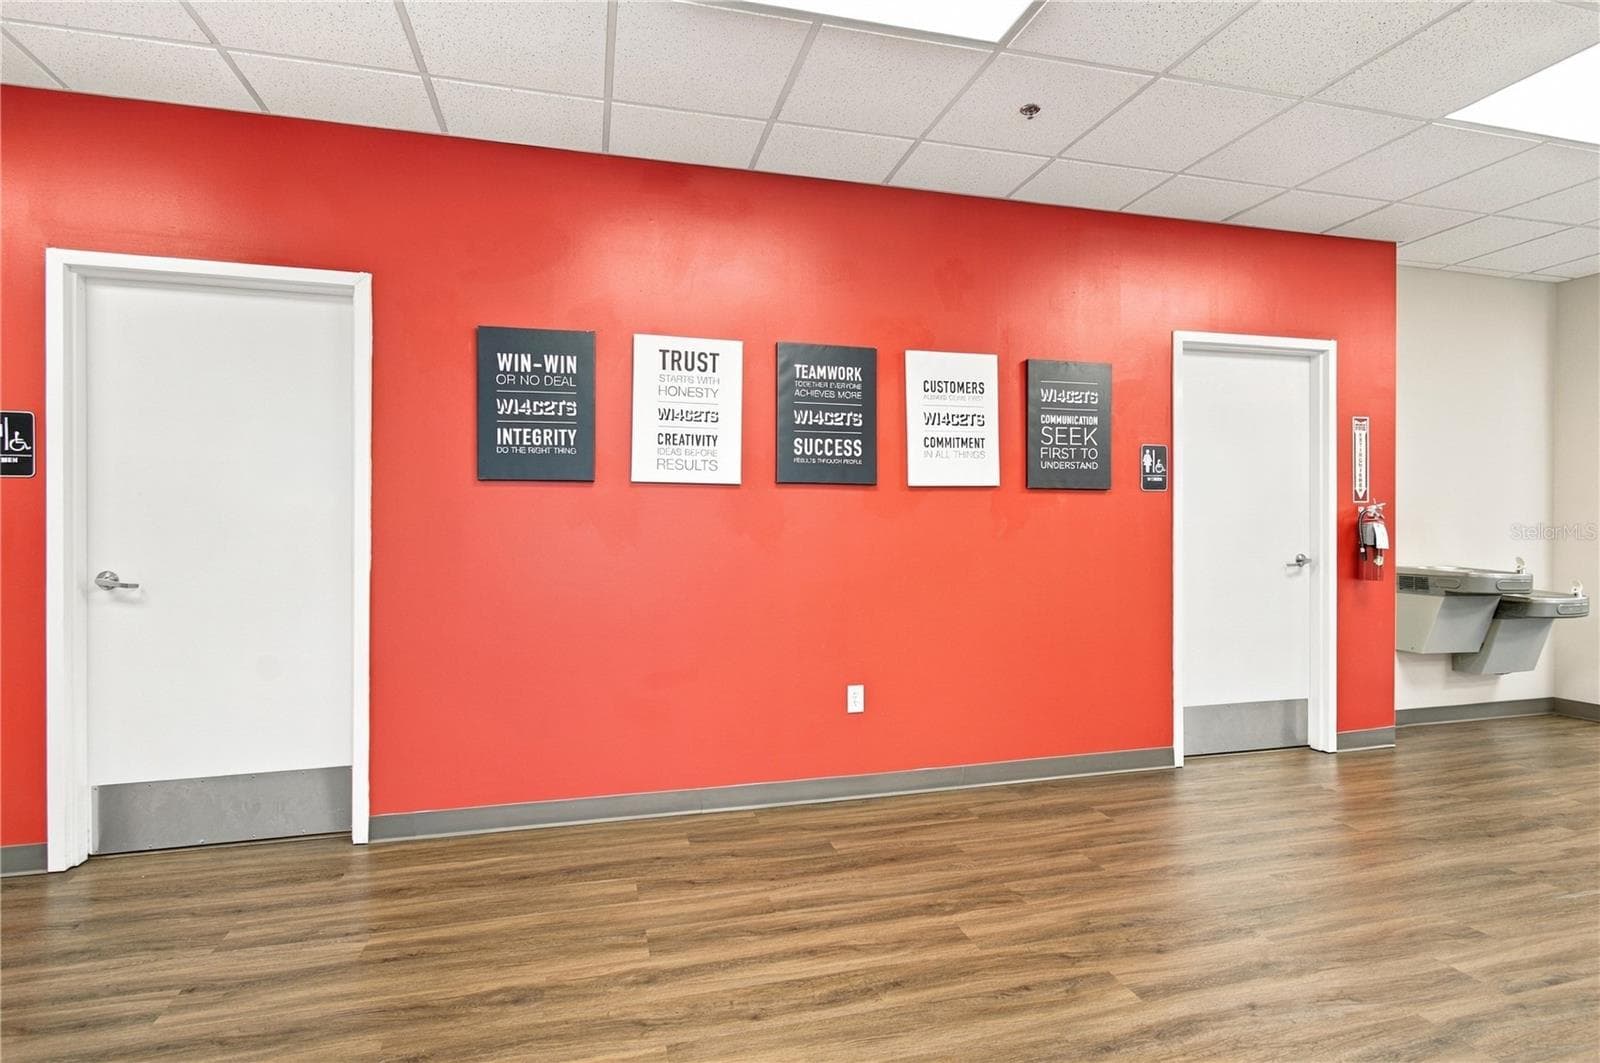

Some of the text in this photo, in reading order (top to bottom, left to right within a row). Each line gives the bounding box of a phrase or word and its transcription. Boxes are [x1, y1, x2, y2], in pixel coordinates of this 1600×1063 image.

[496, 352, 577, 374] WIN-WIN
[659, 349, 720, 373] TRUST
[659, 374, 720, 385] STARTS WITH
[794, 364, 862, 382] TEAMWORK
[496, 373, 577, 387] OR NO DEAL
[658, 385, 719, 398] HONESTY
[794, 388, 862, 400] ACHIEVES MORE
[923, 380, 985, 395] CUSTOMERS
[1040, 414, 1099, 425] COMMUNICATION
[496, 428, 577, 446] INTEGRITY
[657, 432, 718, 447] CREATIVITY
[923, 436, 985, 449] COMMITMENT
[1040, 426, 1098, 446] SEEK
[528, 447, 551, 455] RIGHT
[554, 447, 577, 455] THING
[657, 447, 719, 457] IDEAS BEFORE
[794, 437, 862, 457] SUCCESS
[1040, 447, 1098, 460] FIRST TO
[923, 450, 986, 460] IN ALL THINGS
[657, 458, 719, 472] RESULTS
[1040, 461, 1099, 470] UNDERSTAND
